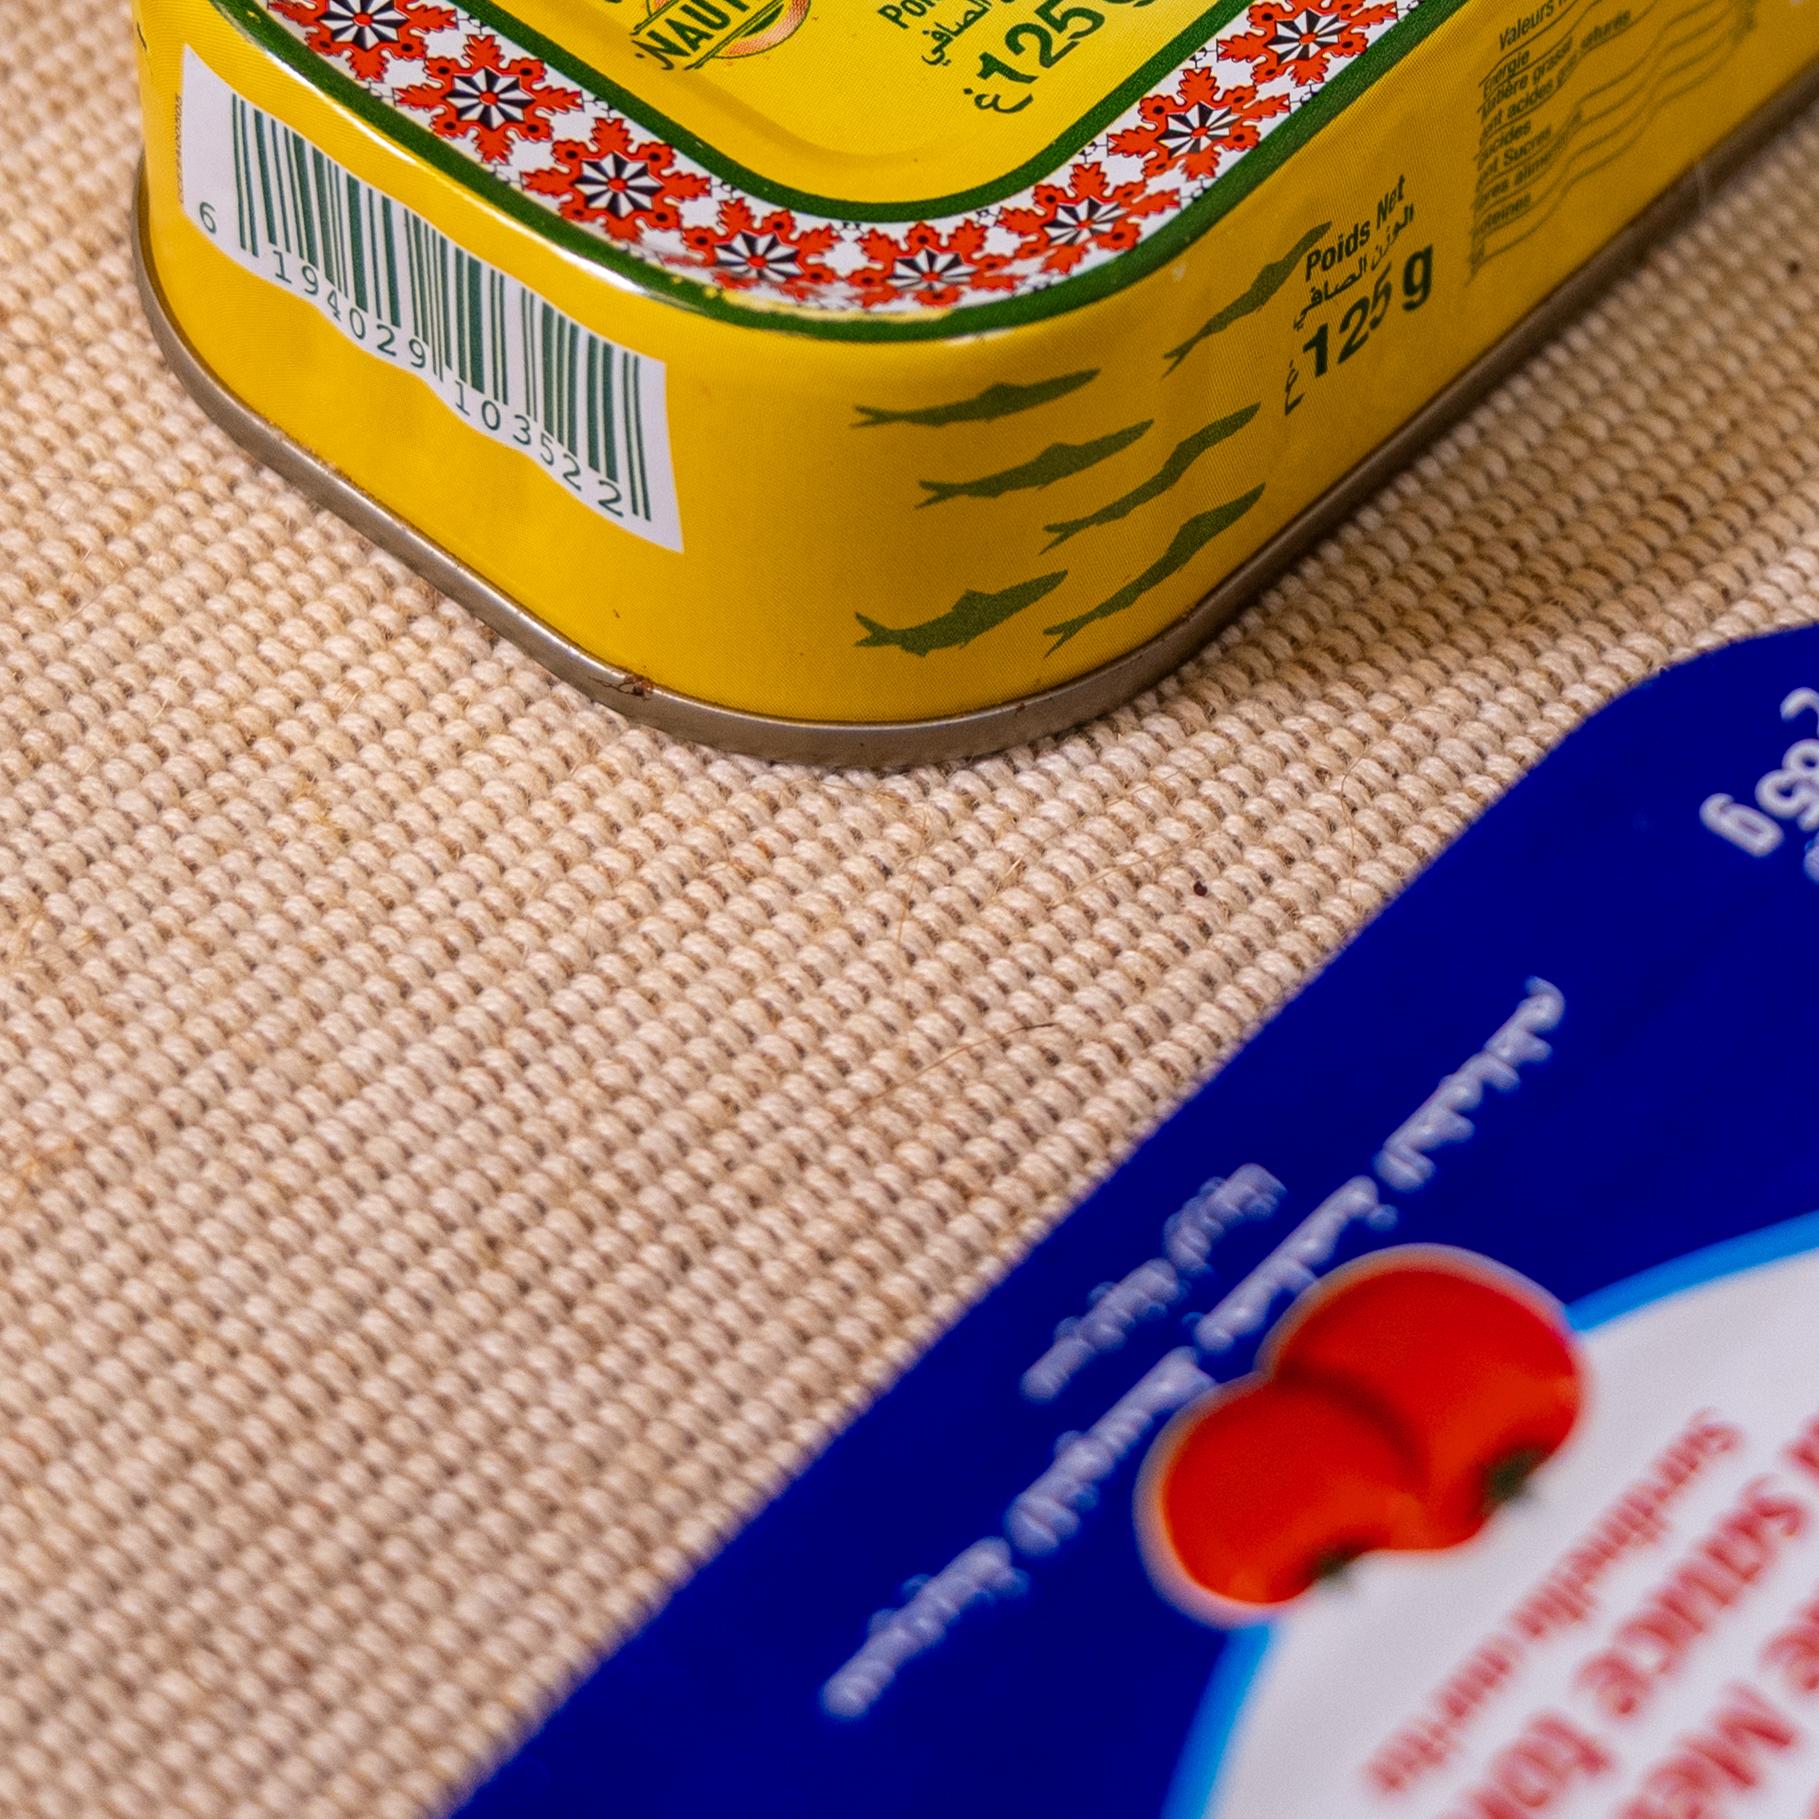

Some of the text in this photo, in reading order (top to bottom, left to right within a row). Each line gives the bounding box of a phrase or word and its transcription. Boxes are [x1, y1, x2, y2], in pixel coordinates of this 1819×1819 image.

[1302, 243, 1433, 377] 125 g
[1306, 220, 1370, 282] Poids
[1377, 174, 1405, 230] Net
[199, 201, 624, 519] 6 194029 103522
[1582, 1481, 1808, 1719] sauce
